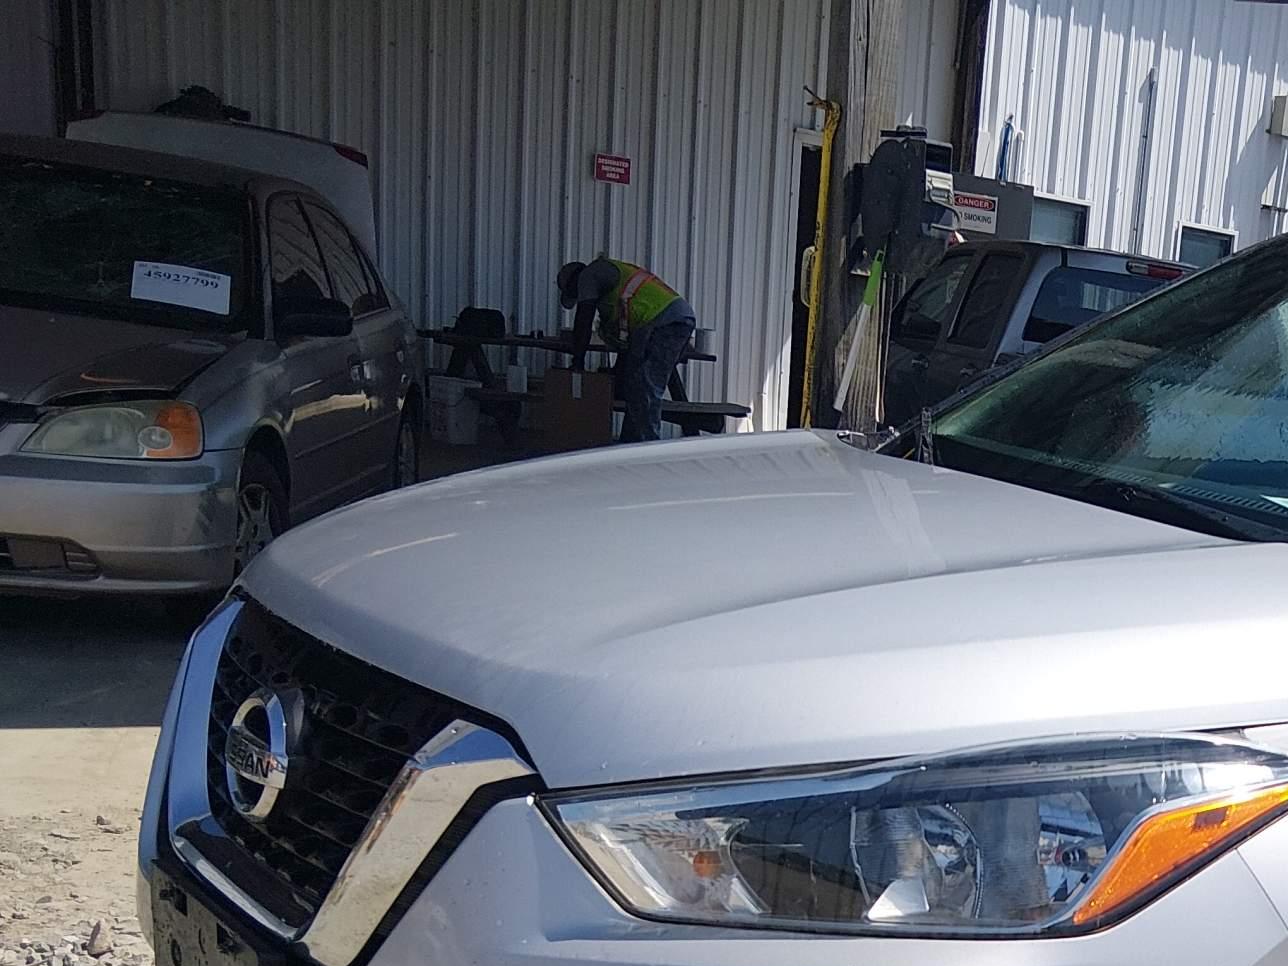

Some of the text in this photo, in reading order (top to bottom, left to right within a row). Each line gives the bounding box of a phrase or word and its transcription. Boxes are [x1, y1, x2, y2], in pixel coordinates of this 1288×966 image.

[958, 197, 990, 208] DANGER
[964, 212, 992, 224] SMOKING
[143, 269, 219, 289] 45927799
